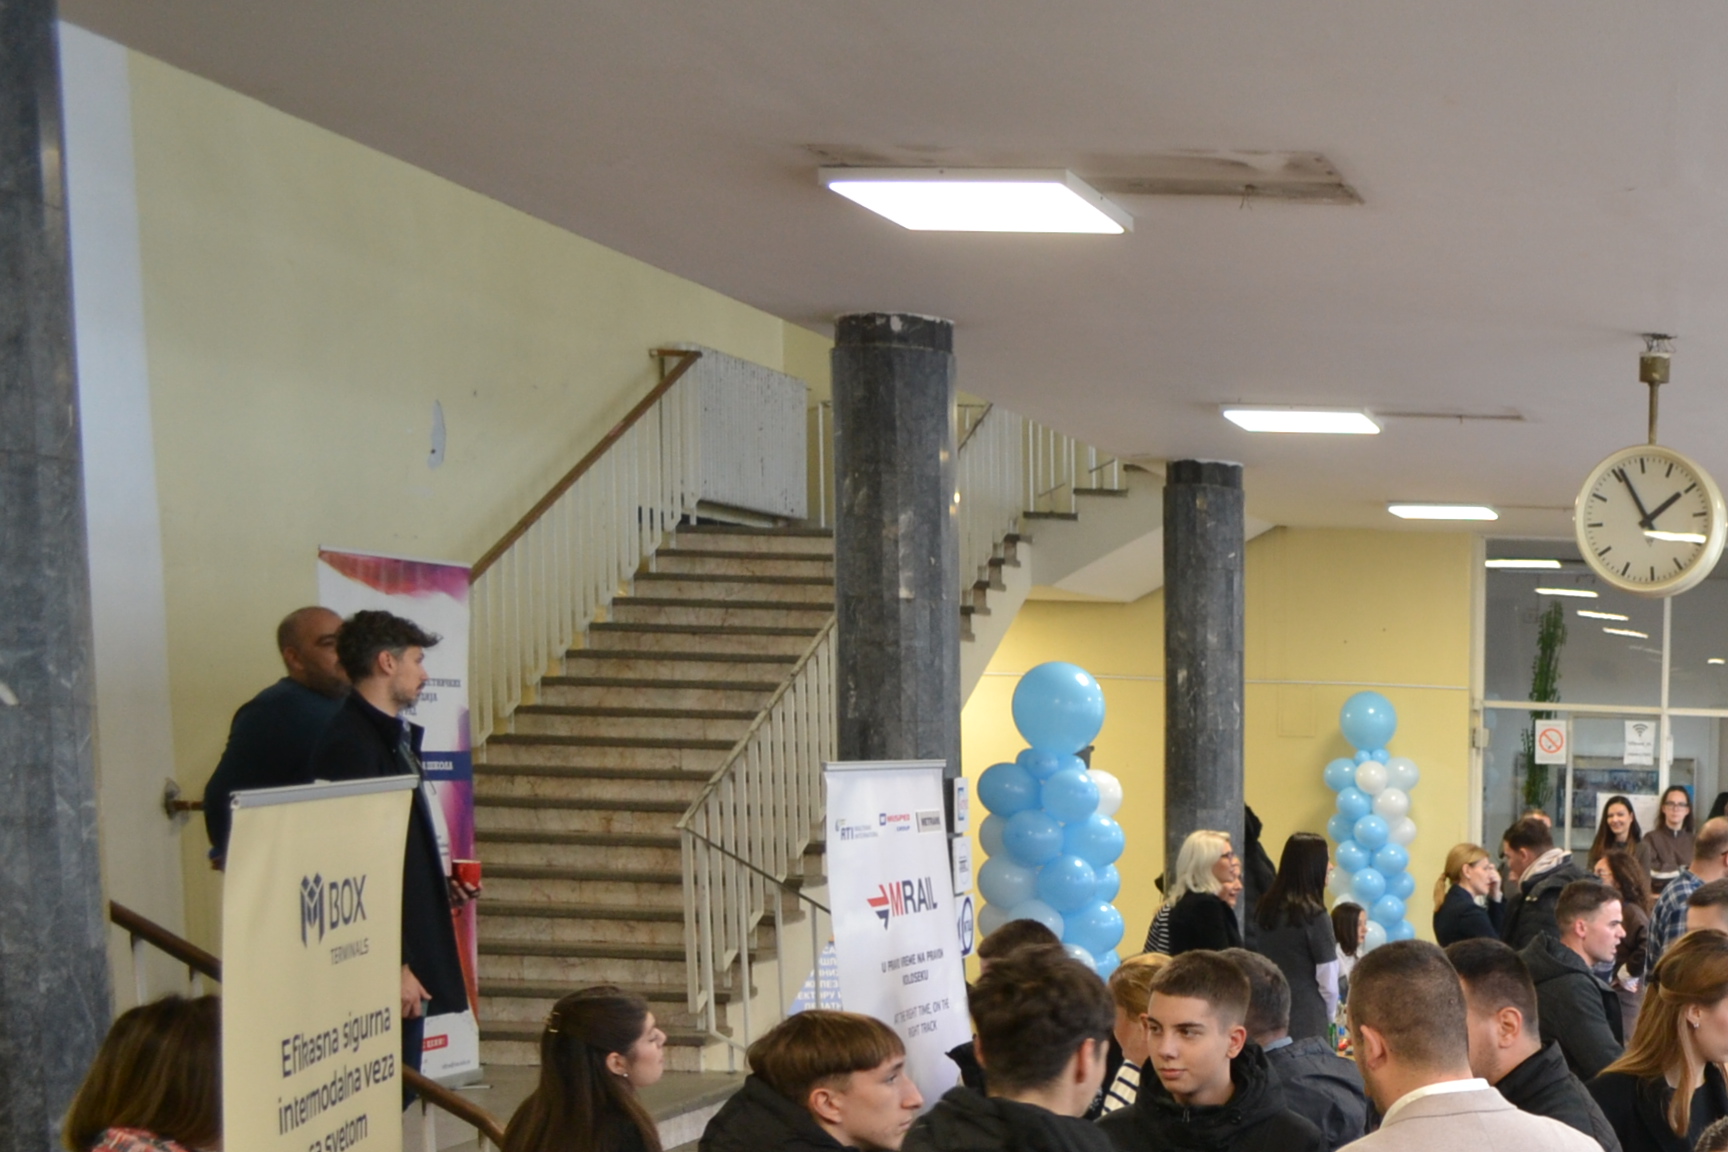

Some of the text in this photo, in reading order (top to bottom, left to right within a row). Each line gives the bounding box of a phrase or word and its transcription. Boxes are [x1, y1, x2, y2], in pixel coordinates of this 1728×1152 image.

[281, 1007, 391, 1079] Efikasna sigurna
[278, 1053, 395, 1136] intermodalna veza
